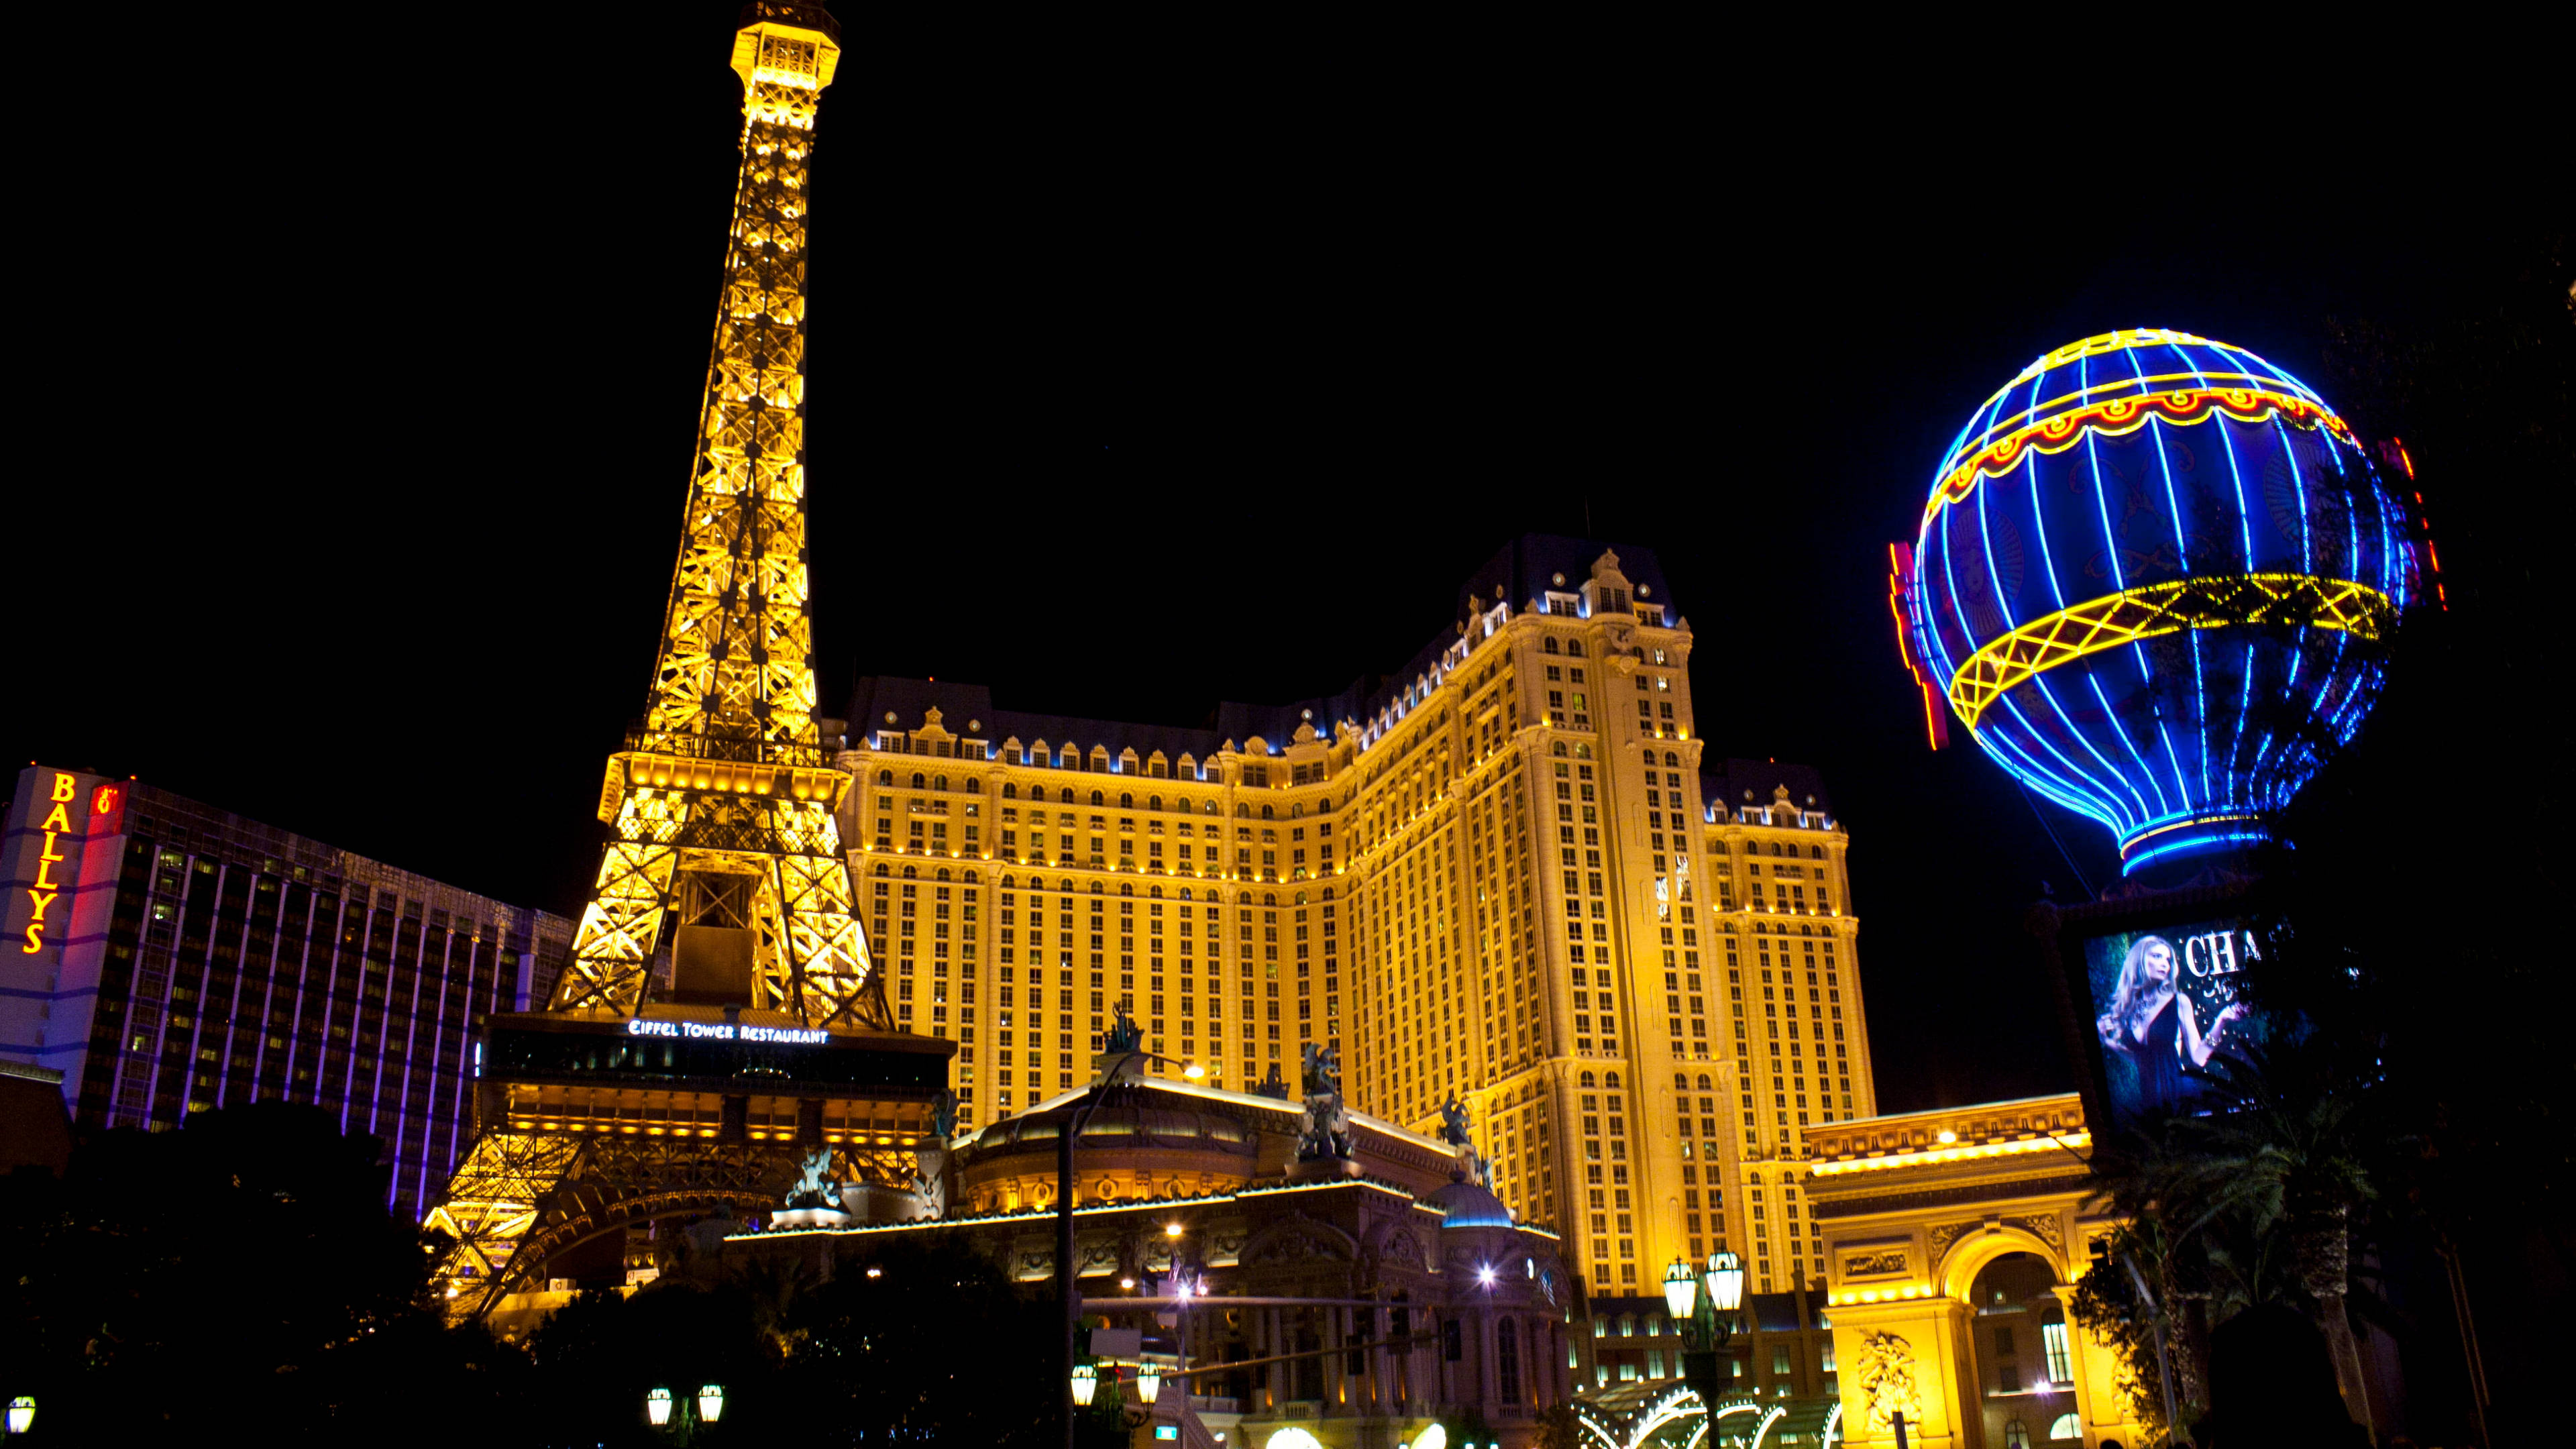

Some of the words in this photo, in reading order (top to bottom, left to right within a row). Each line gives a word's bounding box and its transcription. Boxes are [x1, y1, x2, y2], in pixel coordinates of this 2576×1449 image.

[628, 1019, 679, 1036] EIFFEL
[682, 1022, 734, 1039] TOWER
[740, 1025, 828, 1044] RESTAURANT
